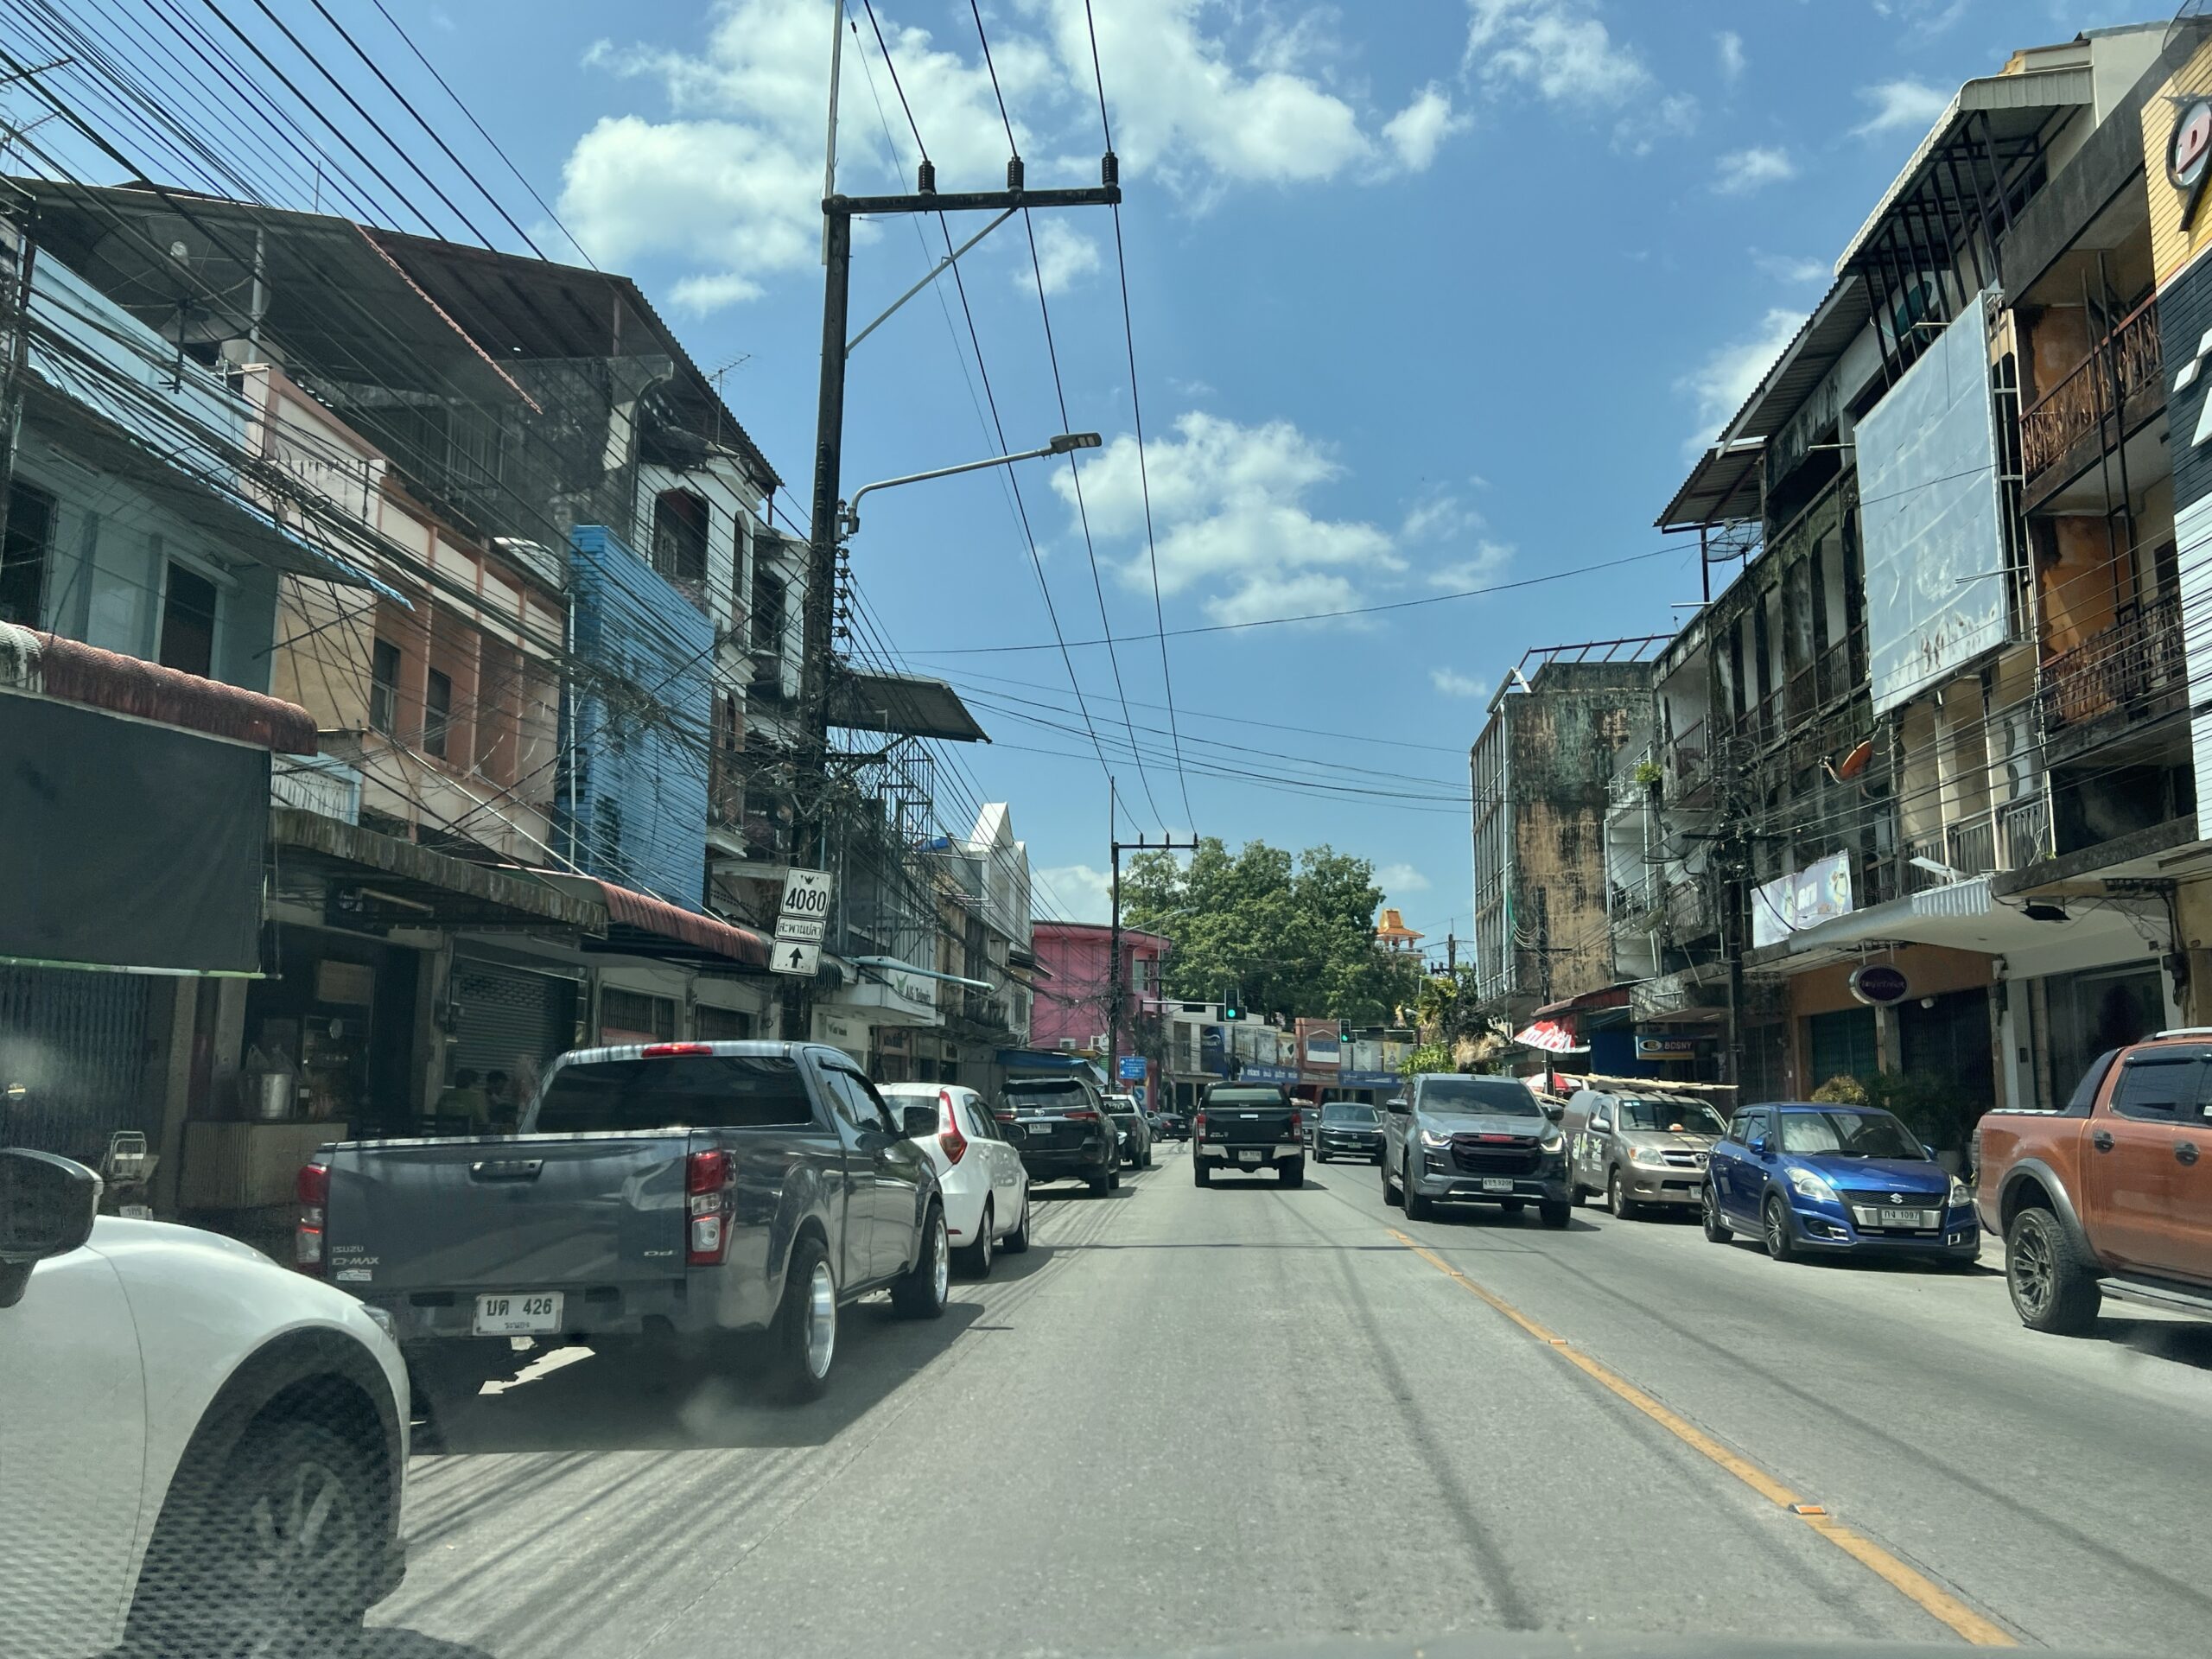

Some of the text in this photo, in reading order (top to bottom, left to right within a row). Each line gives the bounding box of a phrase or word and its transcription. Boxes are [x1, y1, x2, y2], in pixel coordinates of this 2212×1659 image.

[785, 887, 827, 912] 4080
[779, 922, 823, 937] สะพานปลา
[1664, 1041, 1693, 1051] BOSNY
[332, 1244, 365, 1253] ISUZU
[523, 1298, 552, 1315] 426
